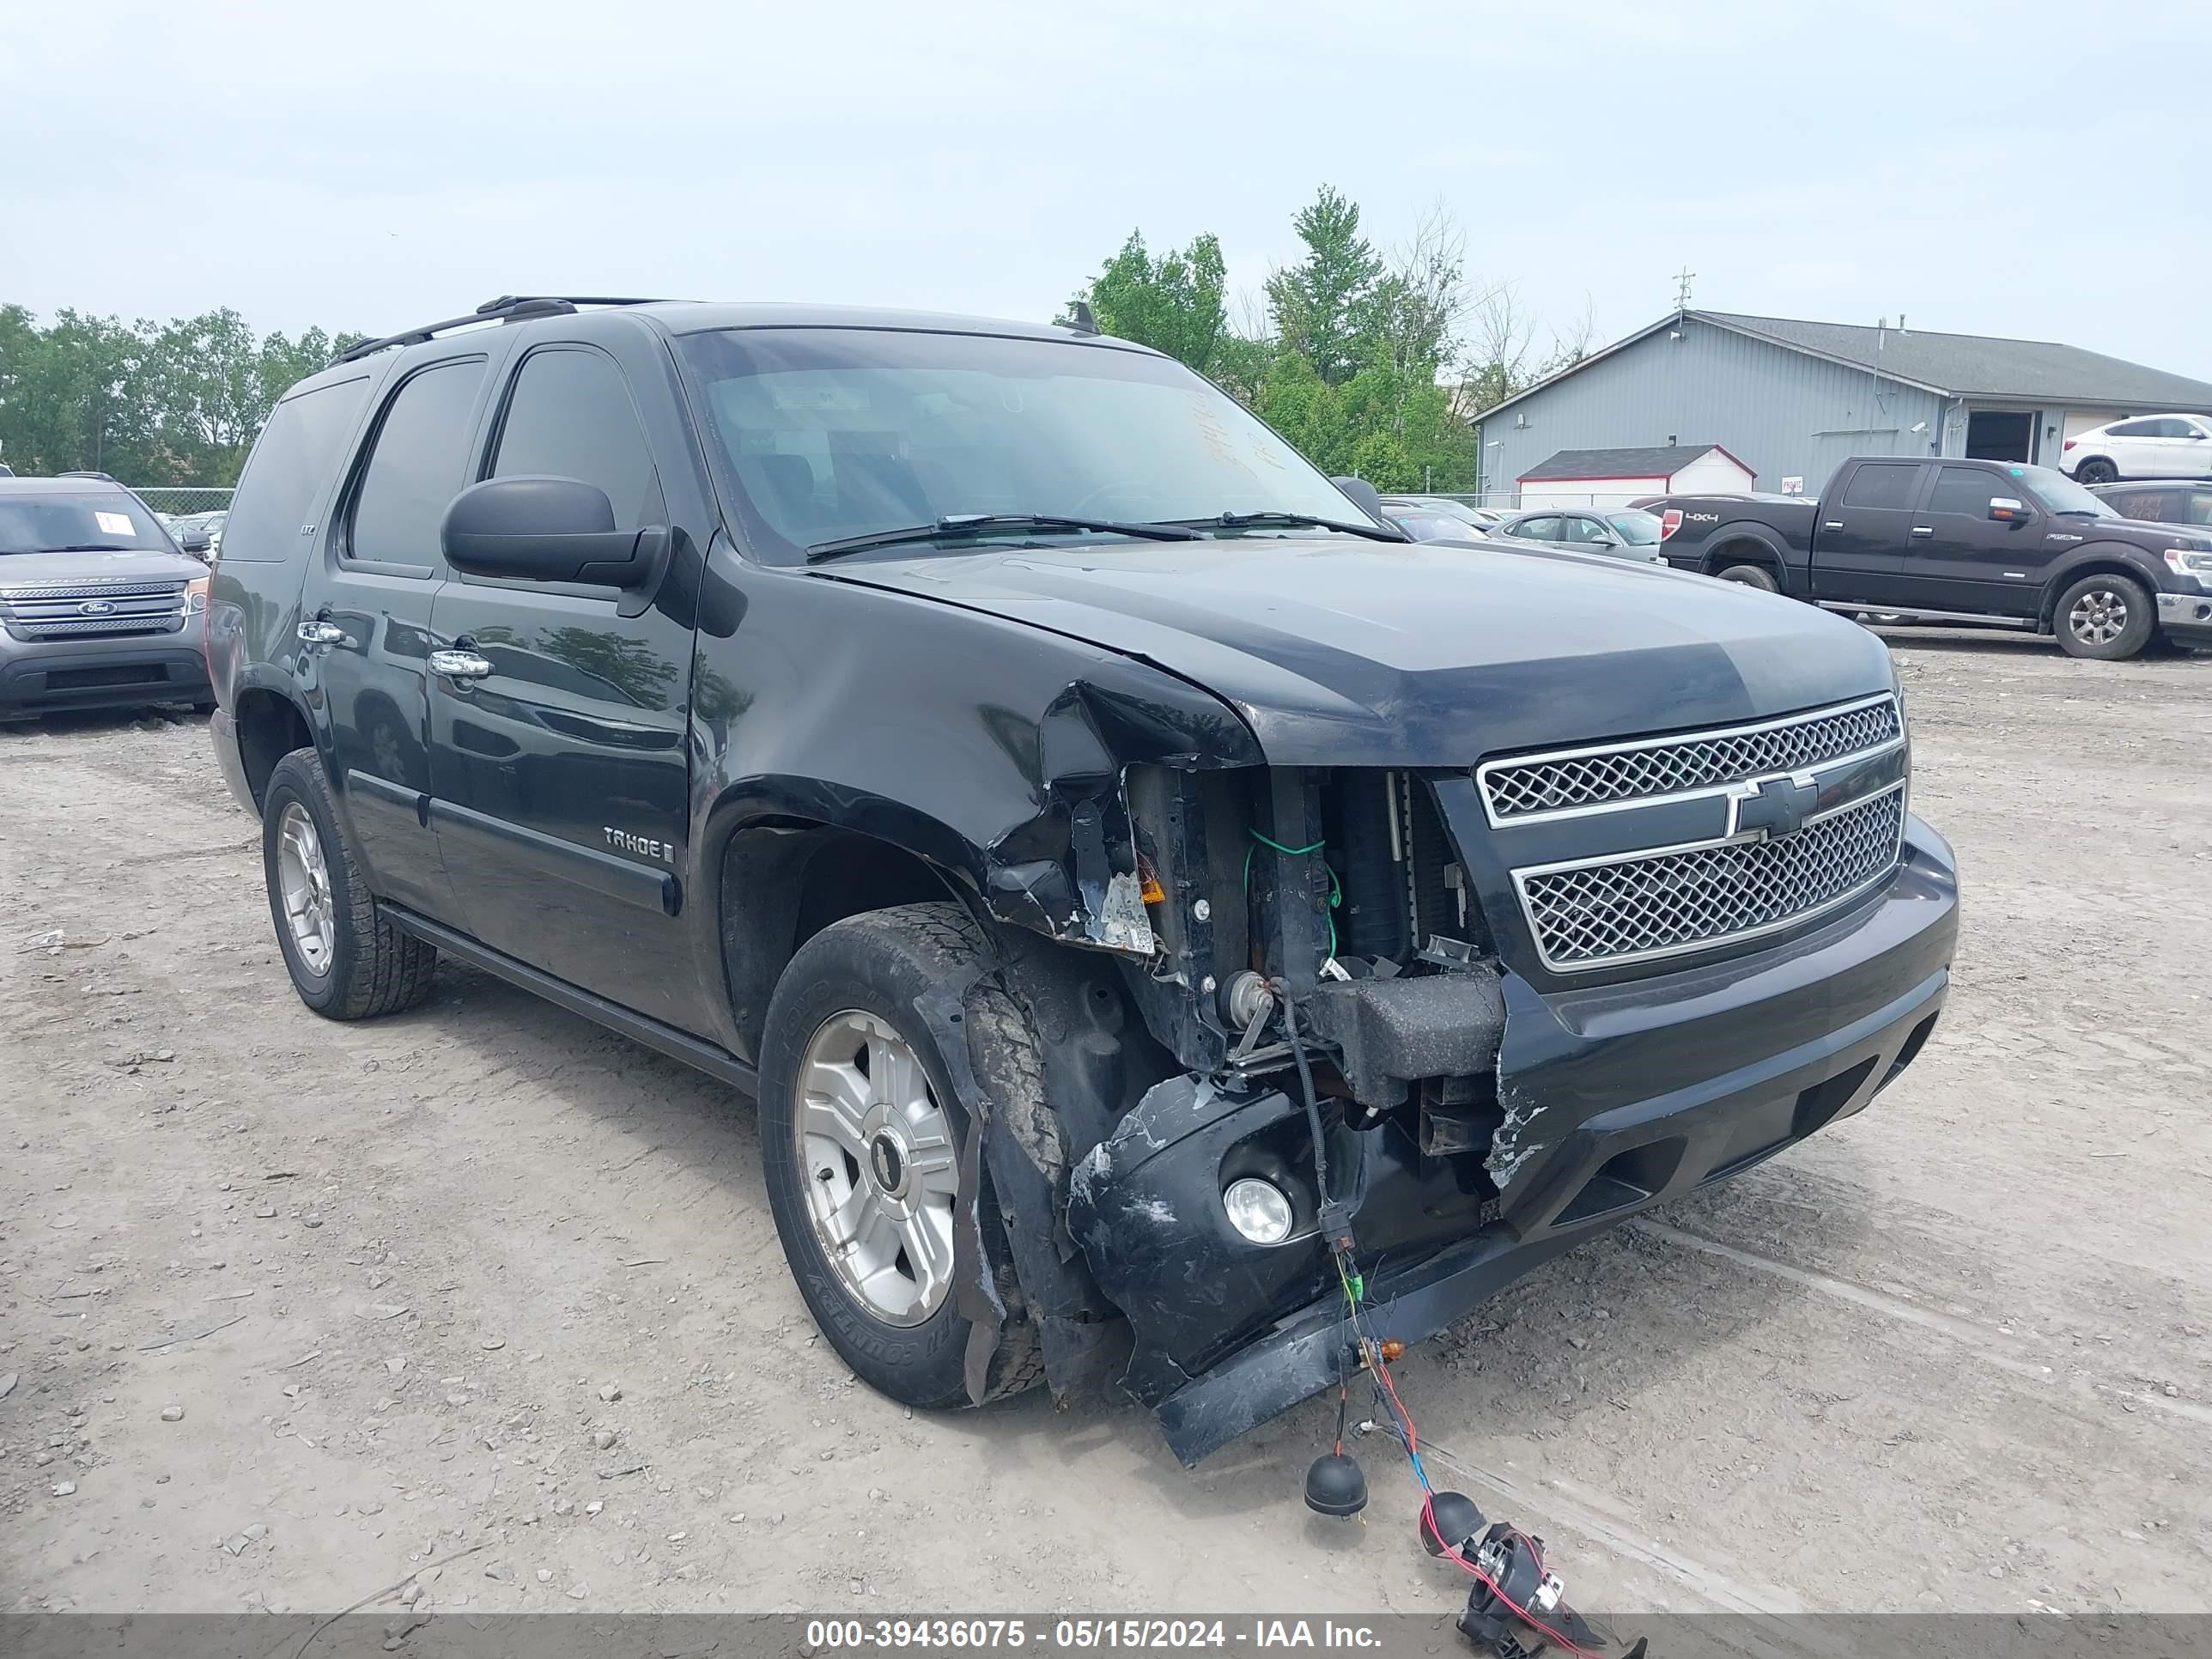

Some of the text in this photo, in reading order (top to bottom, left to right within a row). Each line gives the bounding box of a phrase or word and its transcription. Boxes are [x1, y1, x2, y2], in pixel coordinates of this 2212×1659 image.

[301, 525, 315, 535] LTZ
[22, 576, 127, 585] EXPLORER
[87, 603, 109, 613] Ford
[604, 826, 661, 859] TAHOE
[805, 1273, 919, 1367] COUNTRY
